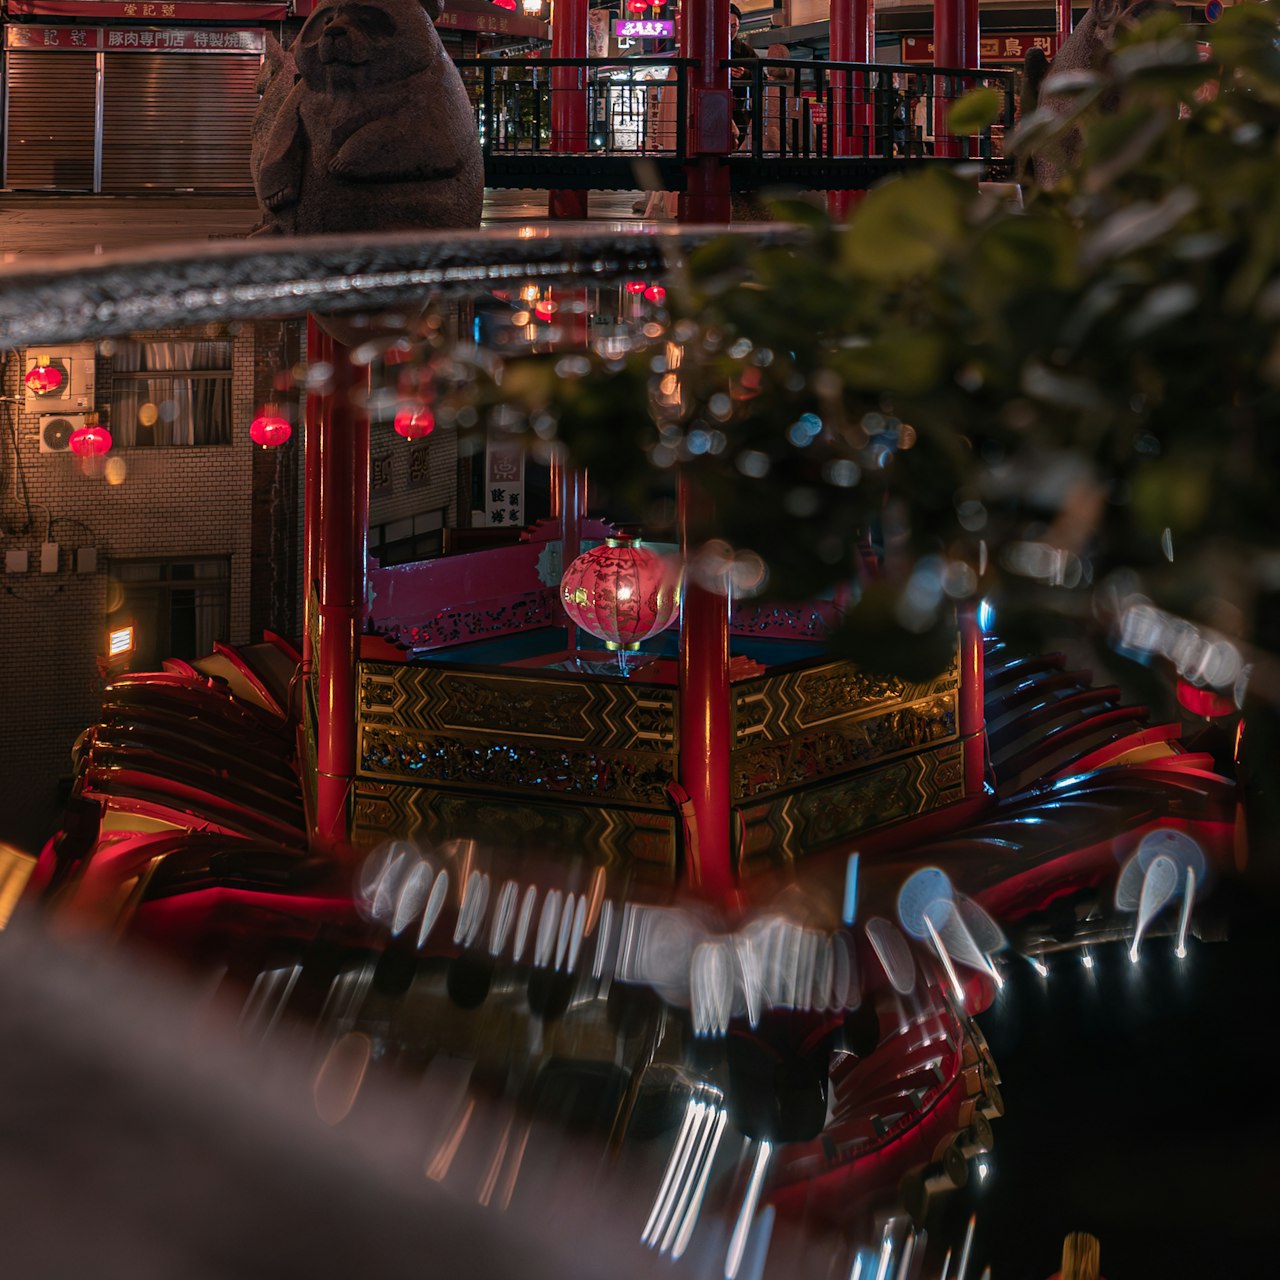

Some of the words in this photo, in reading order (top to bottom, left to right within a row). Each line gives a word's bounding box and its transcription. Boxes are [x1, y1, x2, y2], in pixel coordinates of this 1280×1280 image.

[108, 31, 185, 47] 豚肉専門店
